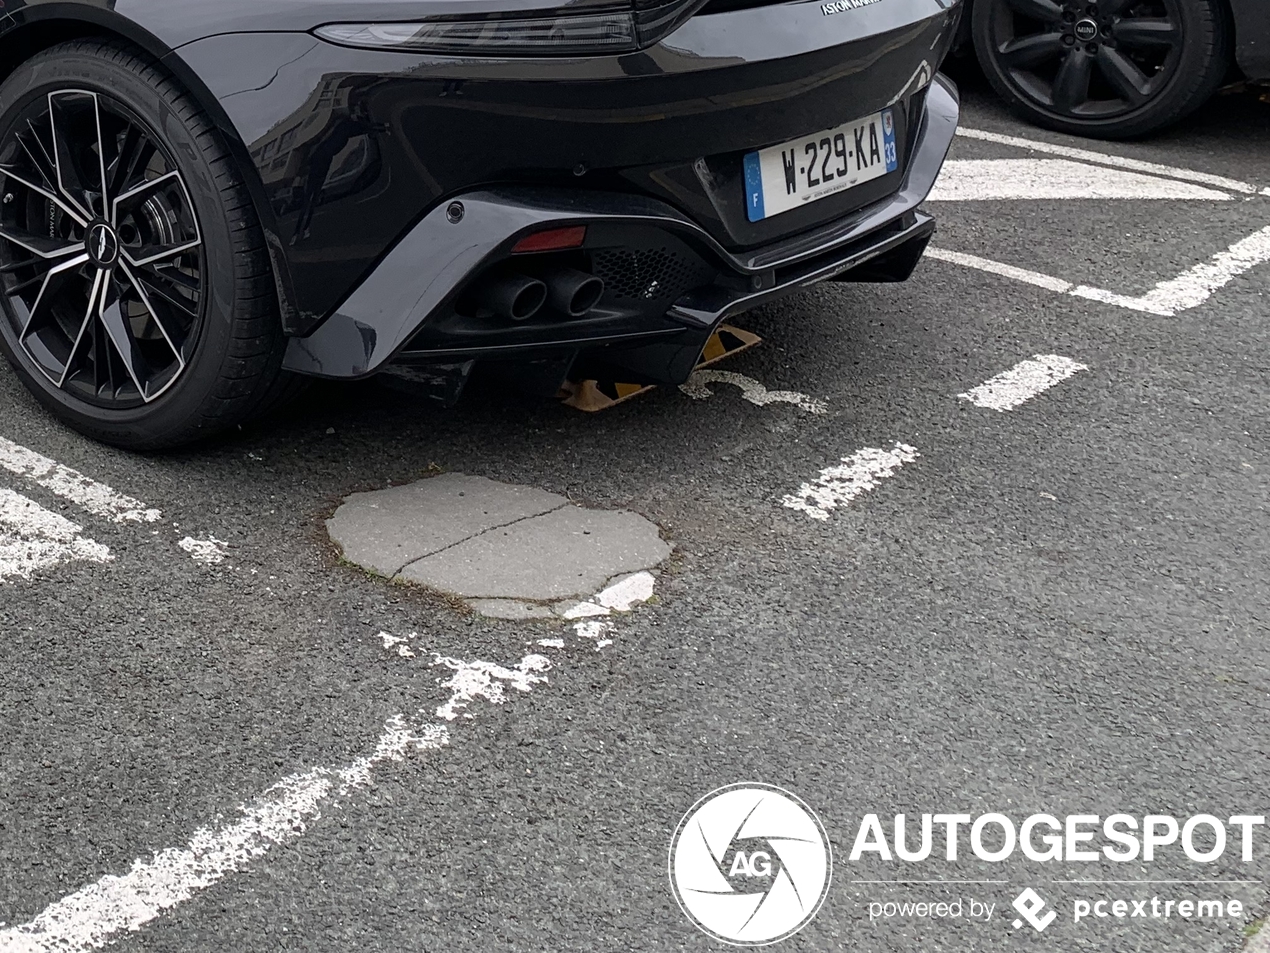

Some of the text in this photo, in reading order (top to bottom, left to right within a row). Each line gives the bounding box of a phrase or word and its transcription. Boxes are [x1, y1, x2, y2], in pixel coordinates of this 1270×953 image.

[820, 0, 851, 16] ASTON
[1077, 26, 1094, 34] MINI
[884, 141, 896, 164] 33
[752, 192, 759, 208] F
